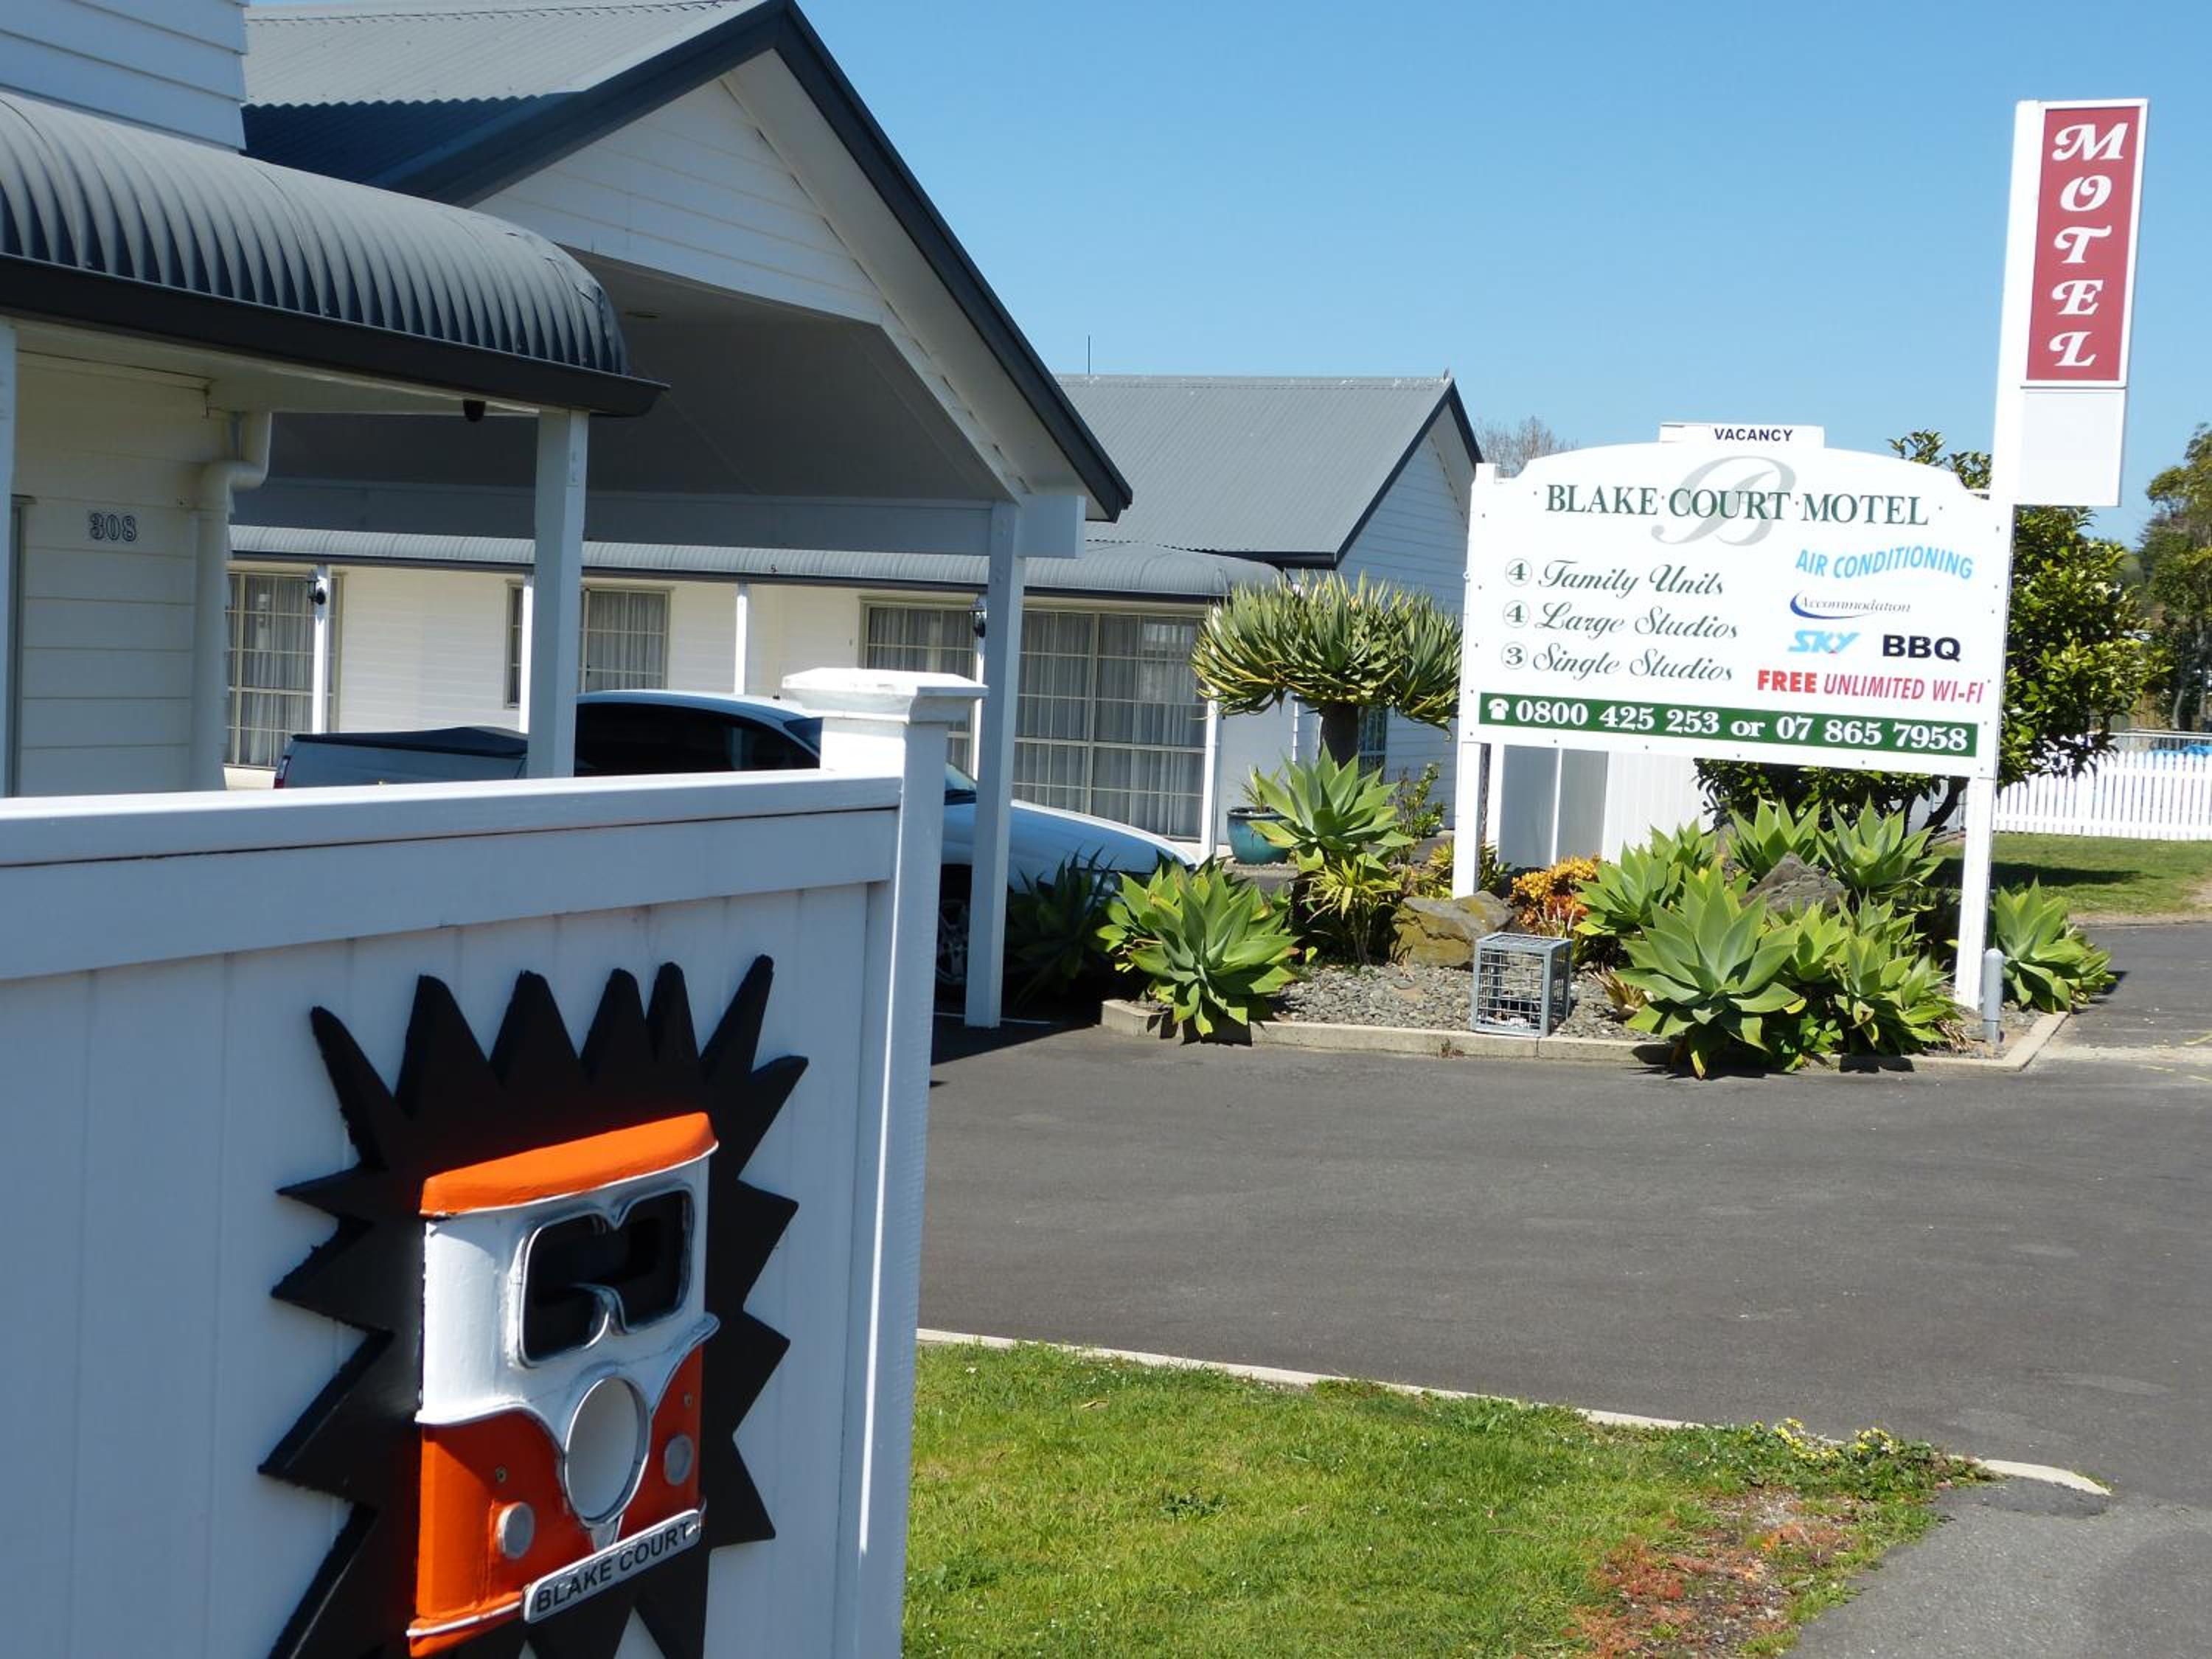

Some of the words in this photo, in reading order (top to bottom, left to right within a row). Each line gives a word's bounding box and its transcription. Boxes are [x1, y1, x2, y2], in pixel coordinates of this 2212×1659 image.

[2048, 122, 2129, 367] MOTEL
[1714, 428, 1794, 442] VACANCY
[1545, 484, 1658, 516] BLAKE
[1668, 487, 1792, 521] COURT
[1800, 493, 1929, 526] MOTEL
[1508, 562, 1527, 581] 4
[1537, 559, 1640, 599] Family
[1649, 563, 1723, 595] Units
[1795, 549, 1828, 577] AIR
[1833, 545, 1975, 580] CONDITIONING
[1506, 604, 1524, 623] 4
[1534, 600, 1625, 640] Large
[1634, 605, 1738, 639] Studios
[1800, 596, 1912, 613] Accommodation
[1505, 646, 1523, 666] 3
[1532, 641, 1621, 681] Single
[1628, 647, 1733, 681] Studios
[1787, 629, 1861, 654] SKY
[1882, 634, 1962, 662] BBQ
[1757, 669, 1818, 694] FREE
[1823, 673, 1925, 700] UNLIMITED
[1932, 679, 1984, 704] WI-FI
[1515, 700, 1589, 726] 0800
[1599, 705, 1655, 731] 425
[1665, 709, 1720, 734] 253
[1730, 720, 1766, 737] or
[1775, 715, 1815, 741] 07
[1823, 719, 1882, 745] 865
[1892, 722, 1969, 751] 7958
[535, 1557, 613, 1613] BLAKE
[619, 1520, 692, 1573] COURT
